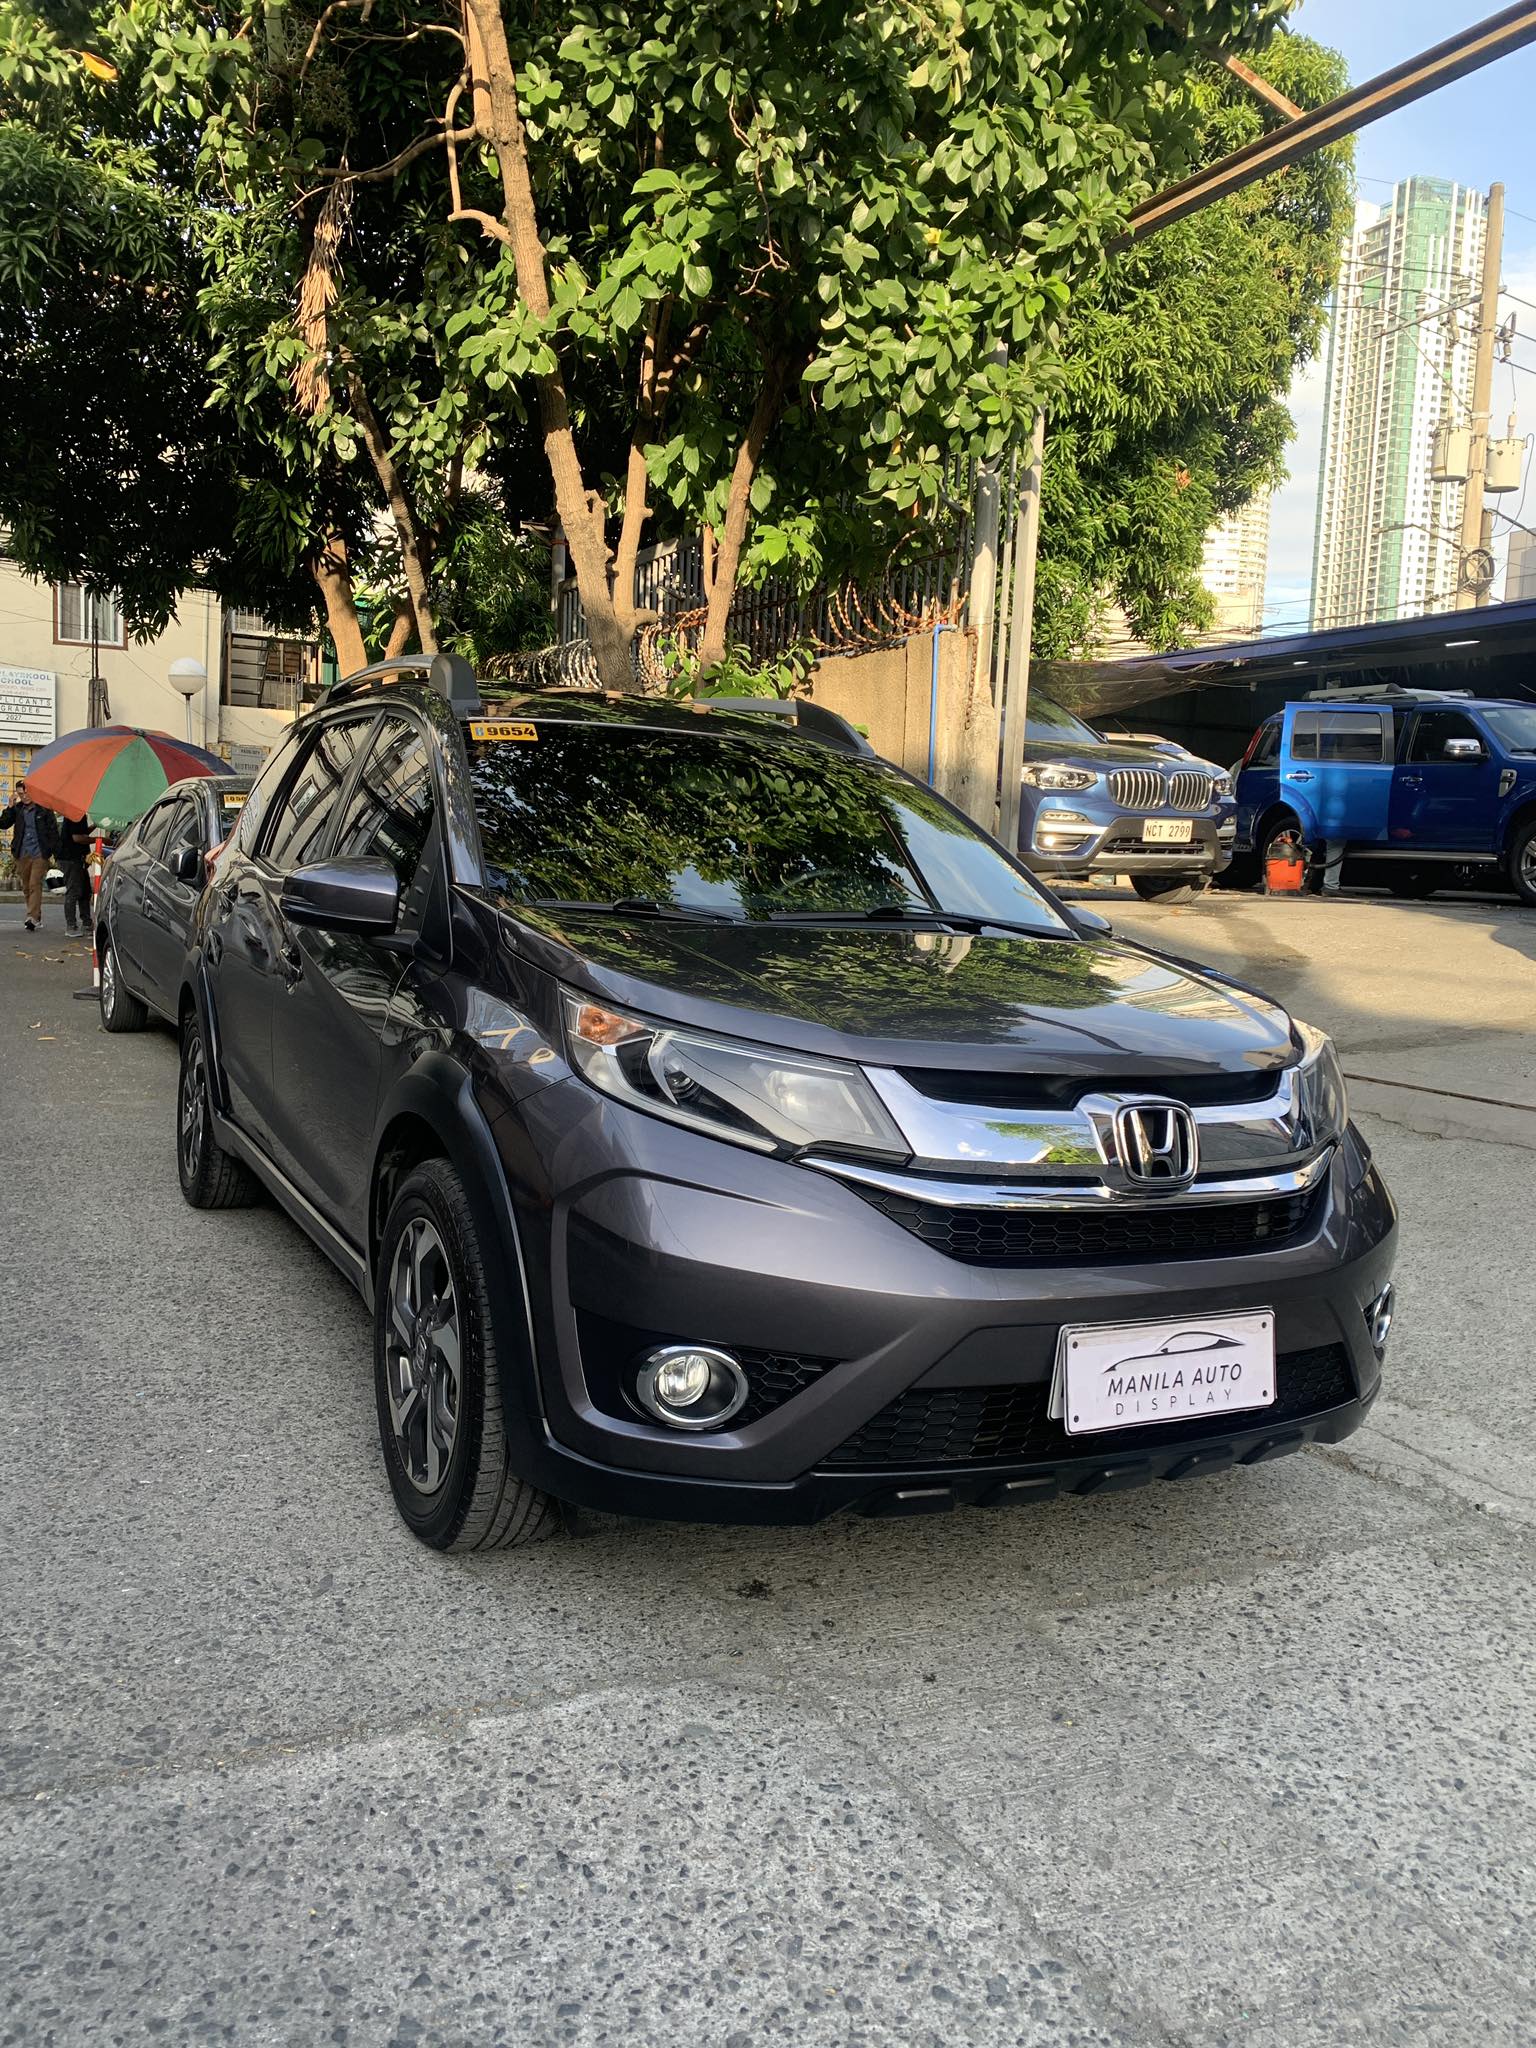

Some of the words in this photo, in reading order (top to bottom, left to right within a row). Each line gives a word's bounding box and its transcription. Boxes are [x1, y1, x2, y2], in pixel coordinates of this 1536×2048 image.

[0, 677, 33, 686] CHOOL
[0, 704, 32, 714] GRADE
[1146, 825, 1163, 837] NCT
[1168, 825, 1191, 838] 2799
[1107, 1370, 1184, 1397] MANILA
[1191, 1363, 1242, 1386] AUTO
[1115, 1388, 1232, 1416] DISPLAY
